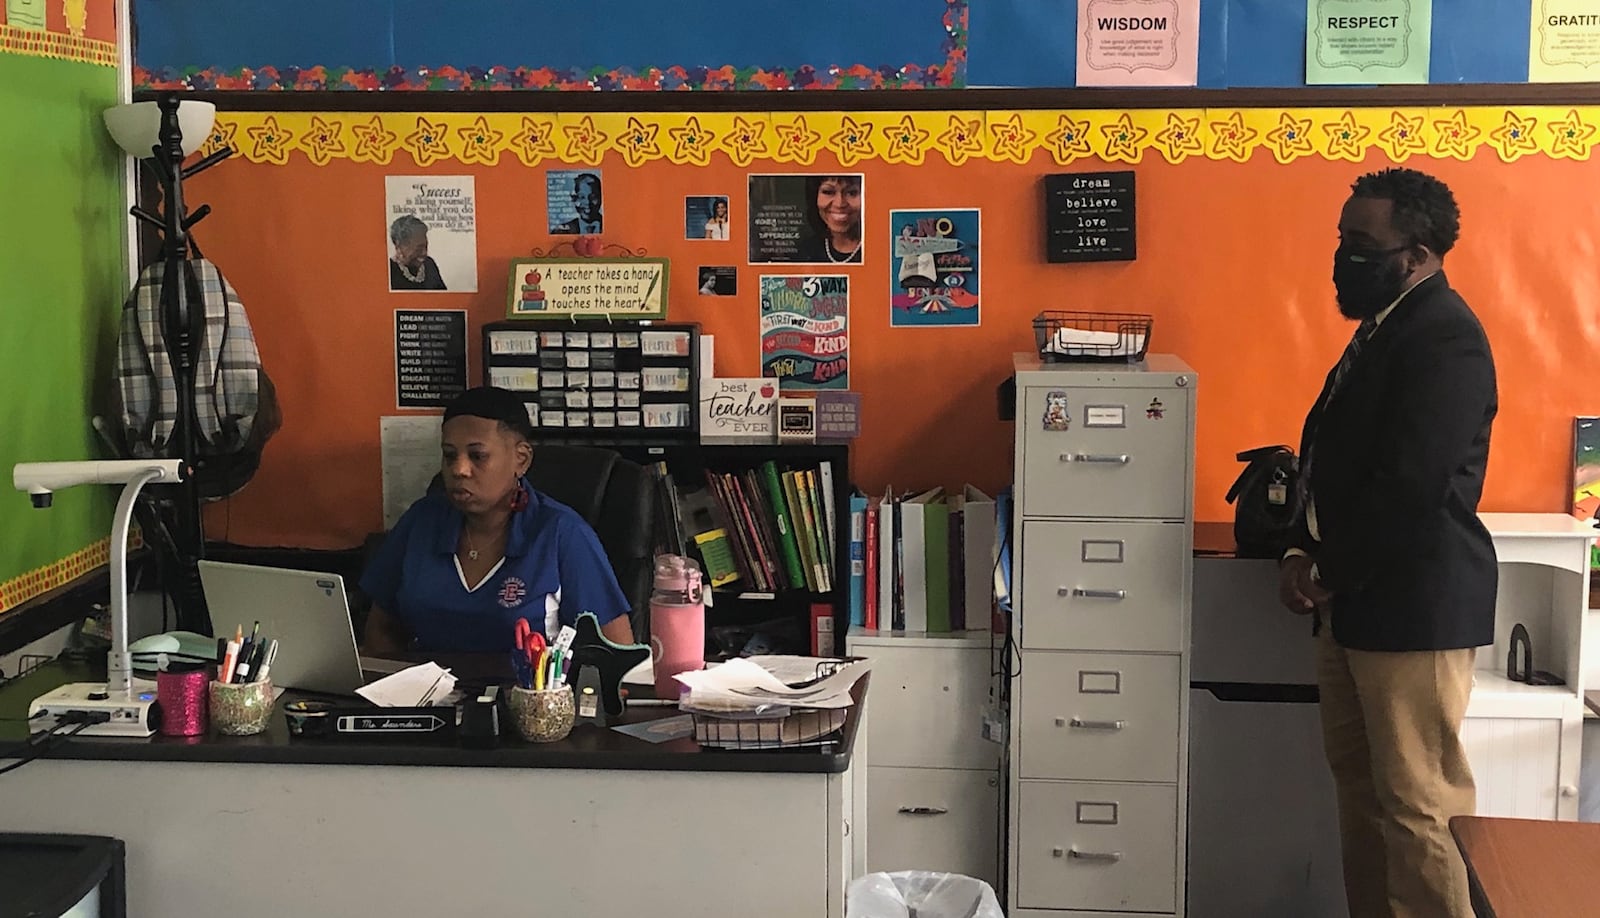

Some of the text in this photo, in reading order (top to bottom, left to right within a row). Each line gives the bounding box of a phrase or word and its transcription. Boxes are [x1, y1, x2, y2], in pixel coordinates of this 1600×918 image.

[1097, 17, 1167, 31] WISDOM
[1327, 16, 1399, 29] RESPECT
[1548, 15, 1600, 26] GRATIT
[1073, 178, 1111, 189] dream
[1066, 197, 1117, 208] believe
[393, 205, 418, 216] liking
[420, 206, 441, 214] what
[443, 206, 459, 216] you
[1077, 217, 1107, 227] love
[1078, 236, 1107, 246] live
[544, 265, 653, 281] A teacher takes a hand
[561, 283, 639, 297] opens the mind
[552, 299, 590, 309] touches
[595, 298, 611, 309] the
[401, 375, 431, 383] EDUCATE
[721, 382, 748, 393] best
[401, 392, 441, 400] CHALLENGE
[700, 391, 776, 419] teacher
[733, 422, 769, 433] EVER
